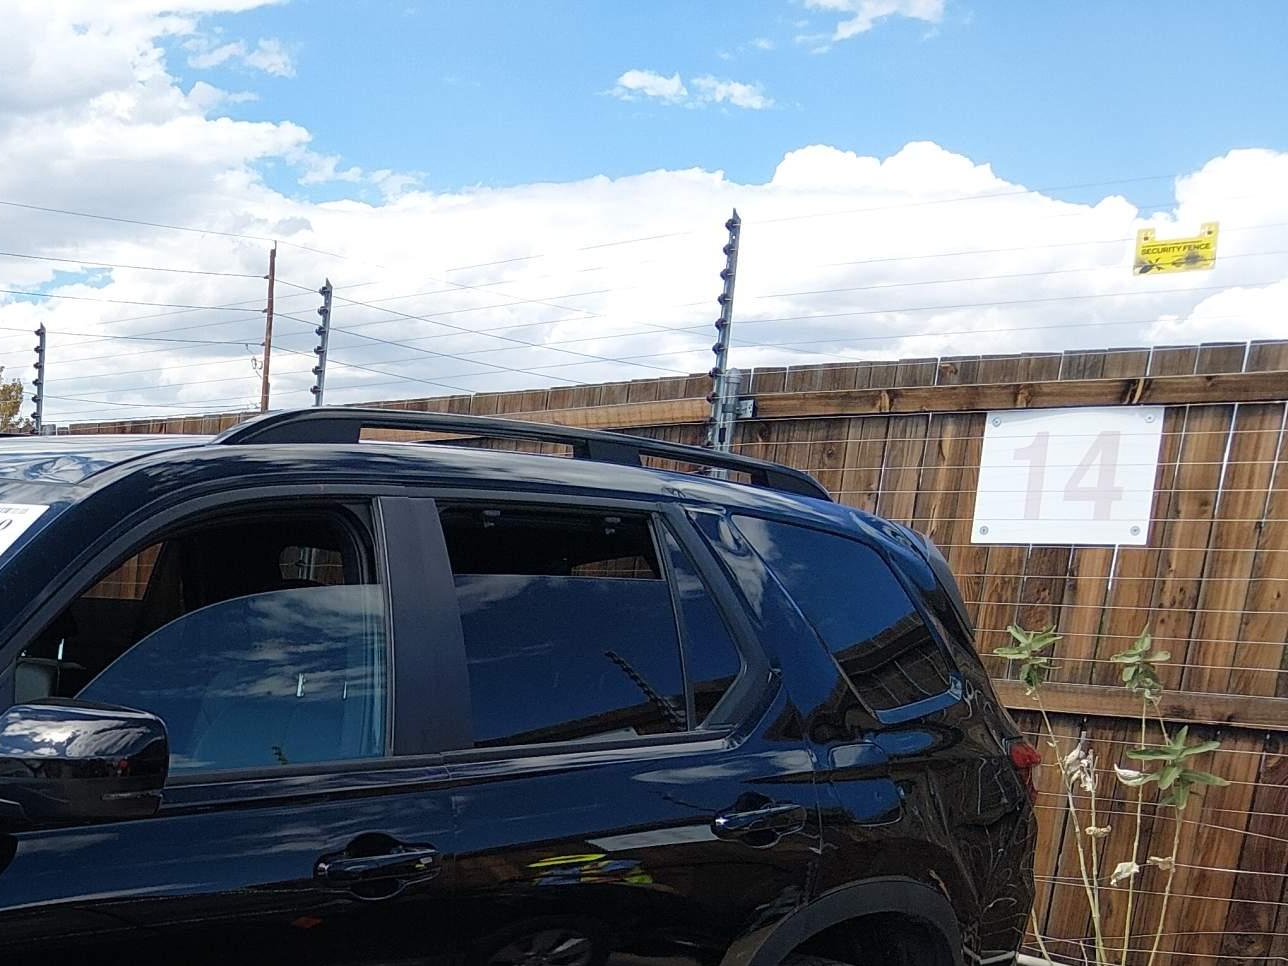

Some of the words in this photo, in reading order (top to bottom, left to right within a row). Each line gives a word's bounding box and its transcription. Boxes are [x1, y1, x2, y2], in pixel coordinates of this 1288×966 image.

[1141, 246, 1182, 256] SECURITY
[1183, 243, 1210, 252] FENCE
[1013, 430, 1124, 520] 14
